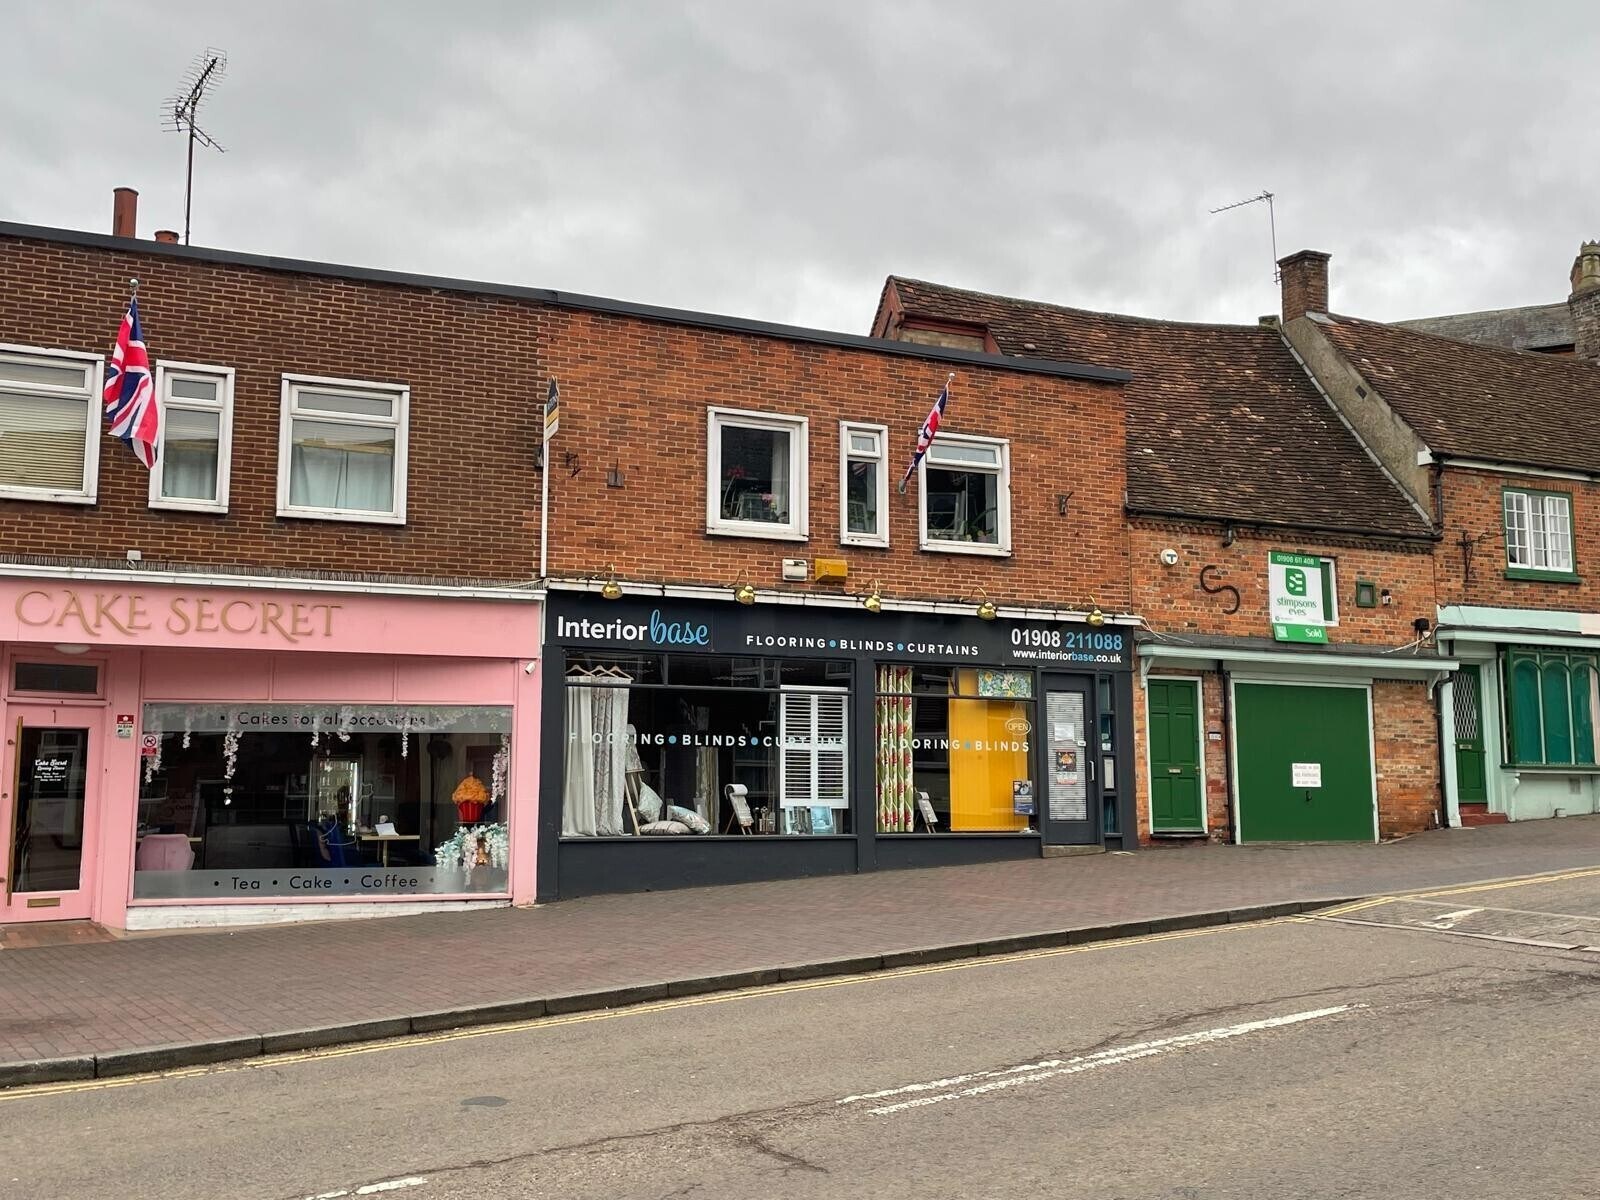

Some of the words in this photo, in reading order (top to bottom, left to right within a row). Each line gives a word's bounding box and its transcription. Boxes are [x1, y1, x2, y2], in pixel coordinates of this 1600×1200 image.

[1276, 595, 1318, 609] stimpsons
[15, 589, 152, 637] CAKE
[166, 597, 344, 644] SECRET
[557, 615, 648, 641] Interior
[650, 609, 710, 645] base
[1304, 628, 1323, 638] Sold
[746, 635, 826, 648] FLOORING
[840, 639, 894, 651] BLINDS
[907, 643, 979, 656] CURTAINS
[1011, 628, 1061, 648] 01908
[1065, 631, 1123, 651] 211088
[1012, 649, 1122, 663] www.interiorbase.co.uk
[237, 712, 288, 725] Cakes
[294, 712, 317, 725] for
[349, 713, 426, 726] occasins
[1007, 722, 1028, 732] OPEN
[569, 732, 665, 746] FOORING
[682, 734, 747, 747] BLINDS
[763, 736, 848, 748] CURTINS
[881, 738, 961, 751] FLOORING
[975, 741, 1030, 752] BLINDS
[231, 876, 261, 890] Tea
[289, 875, 333, 889] Cake
[361, 874, 418, 888] Coffee
